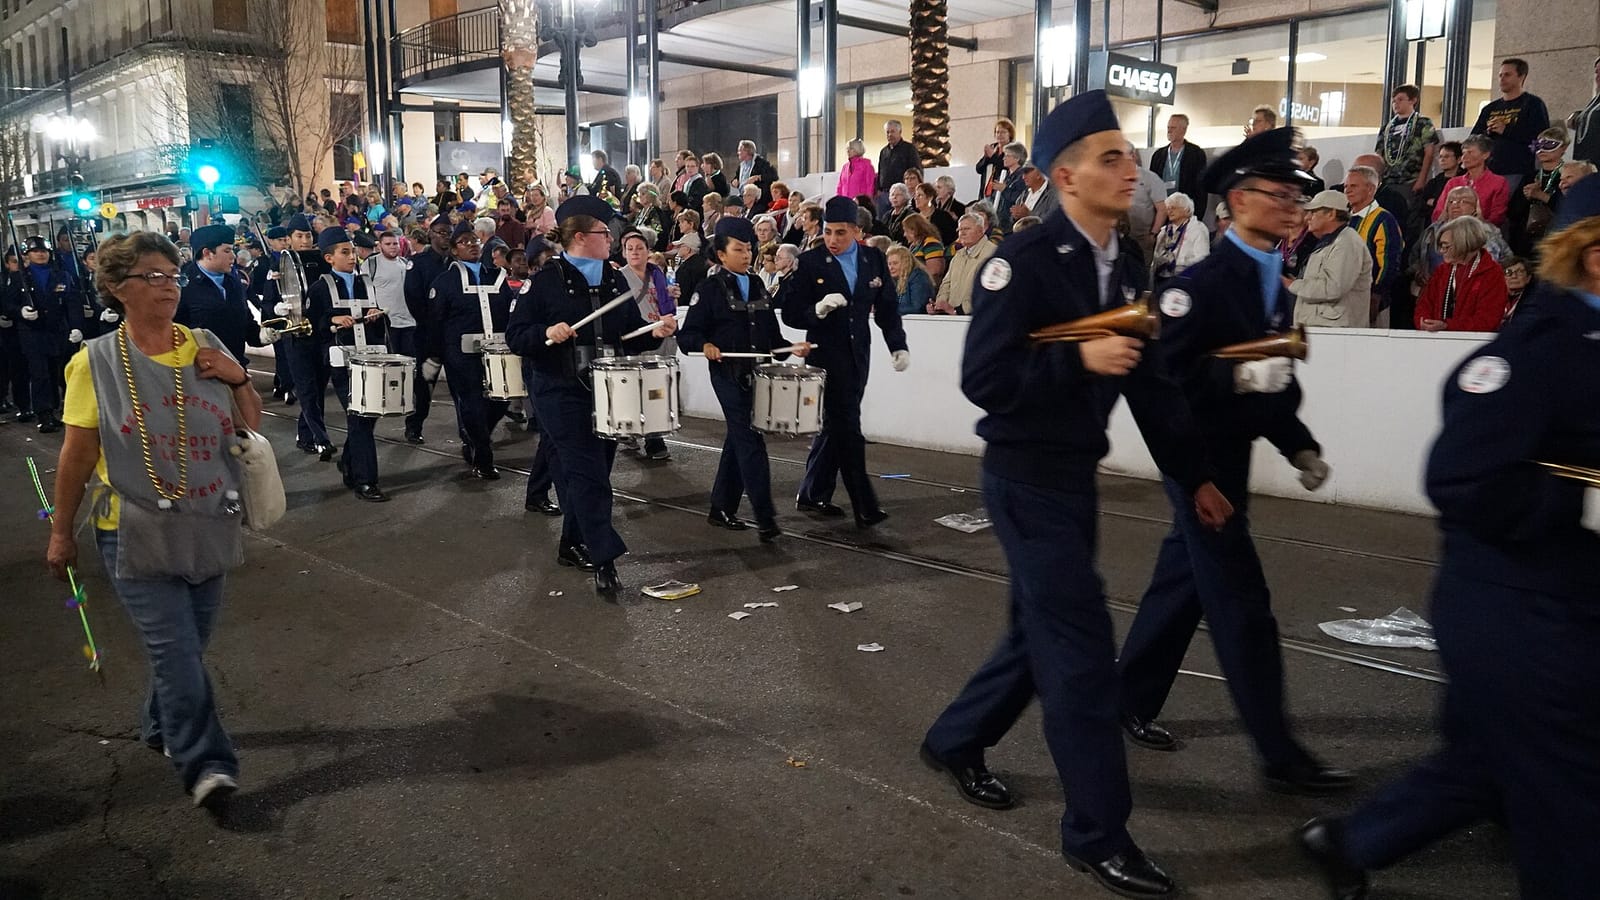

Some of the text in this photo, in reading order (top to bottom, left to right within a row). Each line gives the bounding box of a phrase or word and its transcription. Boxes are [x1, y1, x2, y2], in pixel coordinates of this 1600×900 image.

[1109, 64, 1160, 93] CHASE
[120, 402, 151, 434] WET
[149, 434, 217, 448] AFJOTC
